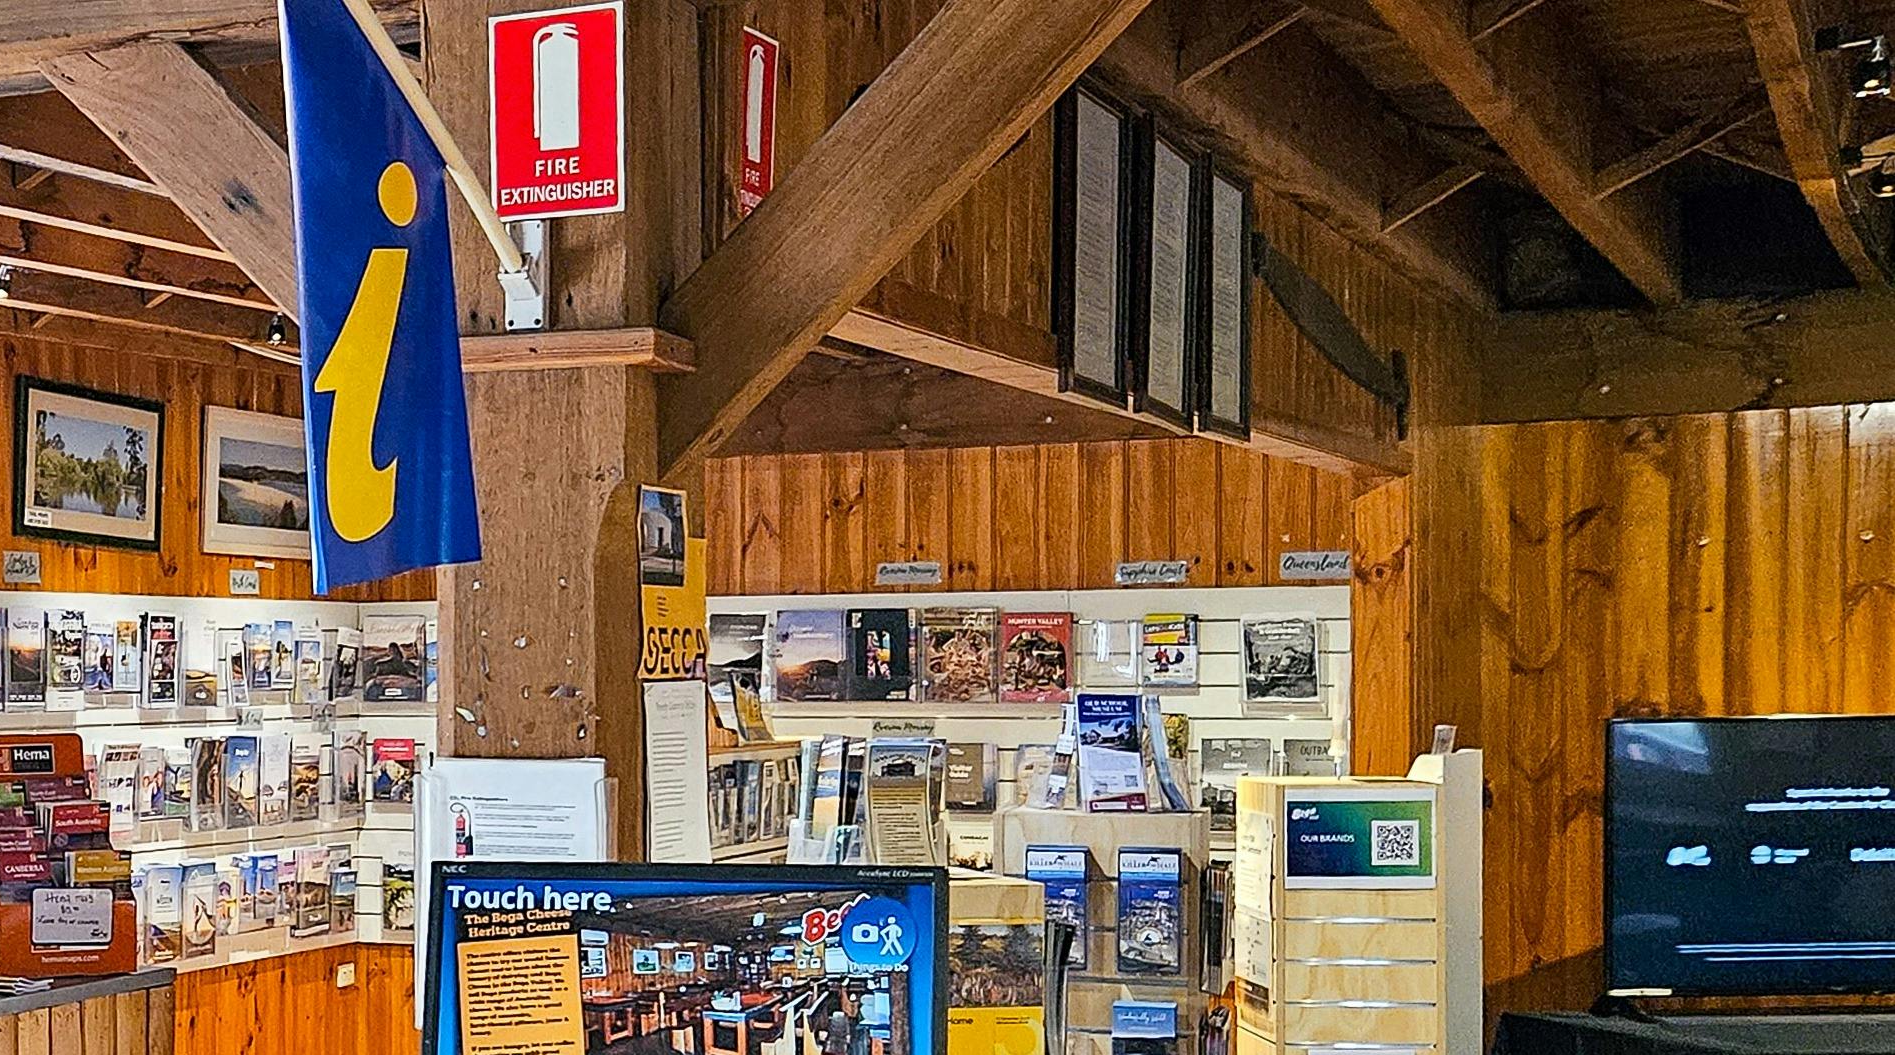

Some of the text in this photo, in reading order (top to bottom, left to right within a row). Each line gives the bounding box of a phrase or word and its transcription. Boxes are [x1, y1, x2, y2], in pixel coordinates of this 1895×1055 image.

[535, 157, 581, 176] FIRE
[501, 179, 615, 206] EXTINGUISHER
[1283, 554, 1350, 571] Queensland
[1037, 617, 1063, 625] VALLEY
[13, 750, 50, 762] Hema
[1300, 745, 1332, 755] OUTBA
[1300, 834, 1356, 843] OUR BRANDS
[441, 865, 467, 874] NEC
[892, 870, 910, 878] LCD
[447, 885, 613, 912] Touch here
[464, 908, 573, 926] The Bega Cheese
[467, 921, 571, 938] Heritage Centre
[893, 963, 909, 973] Do
